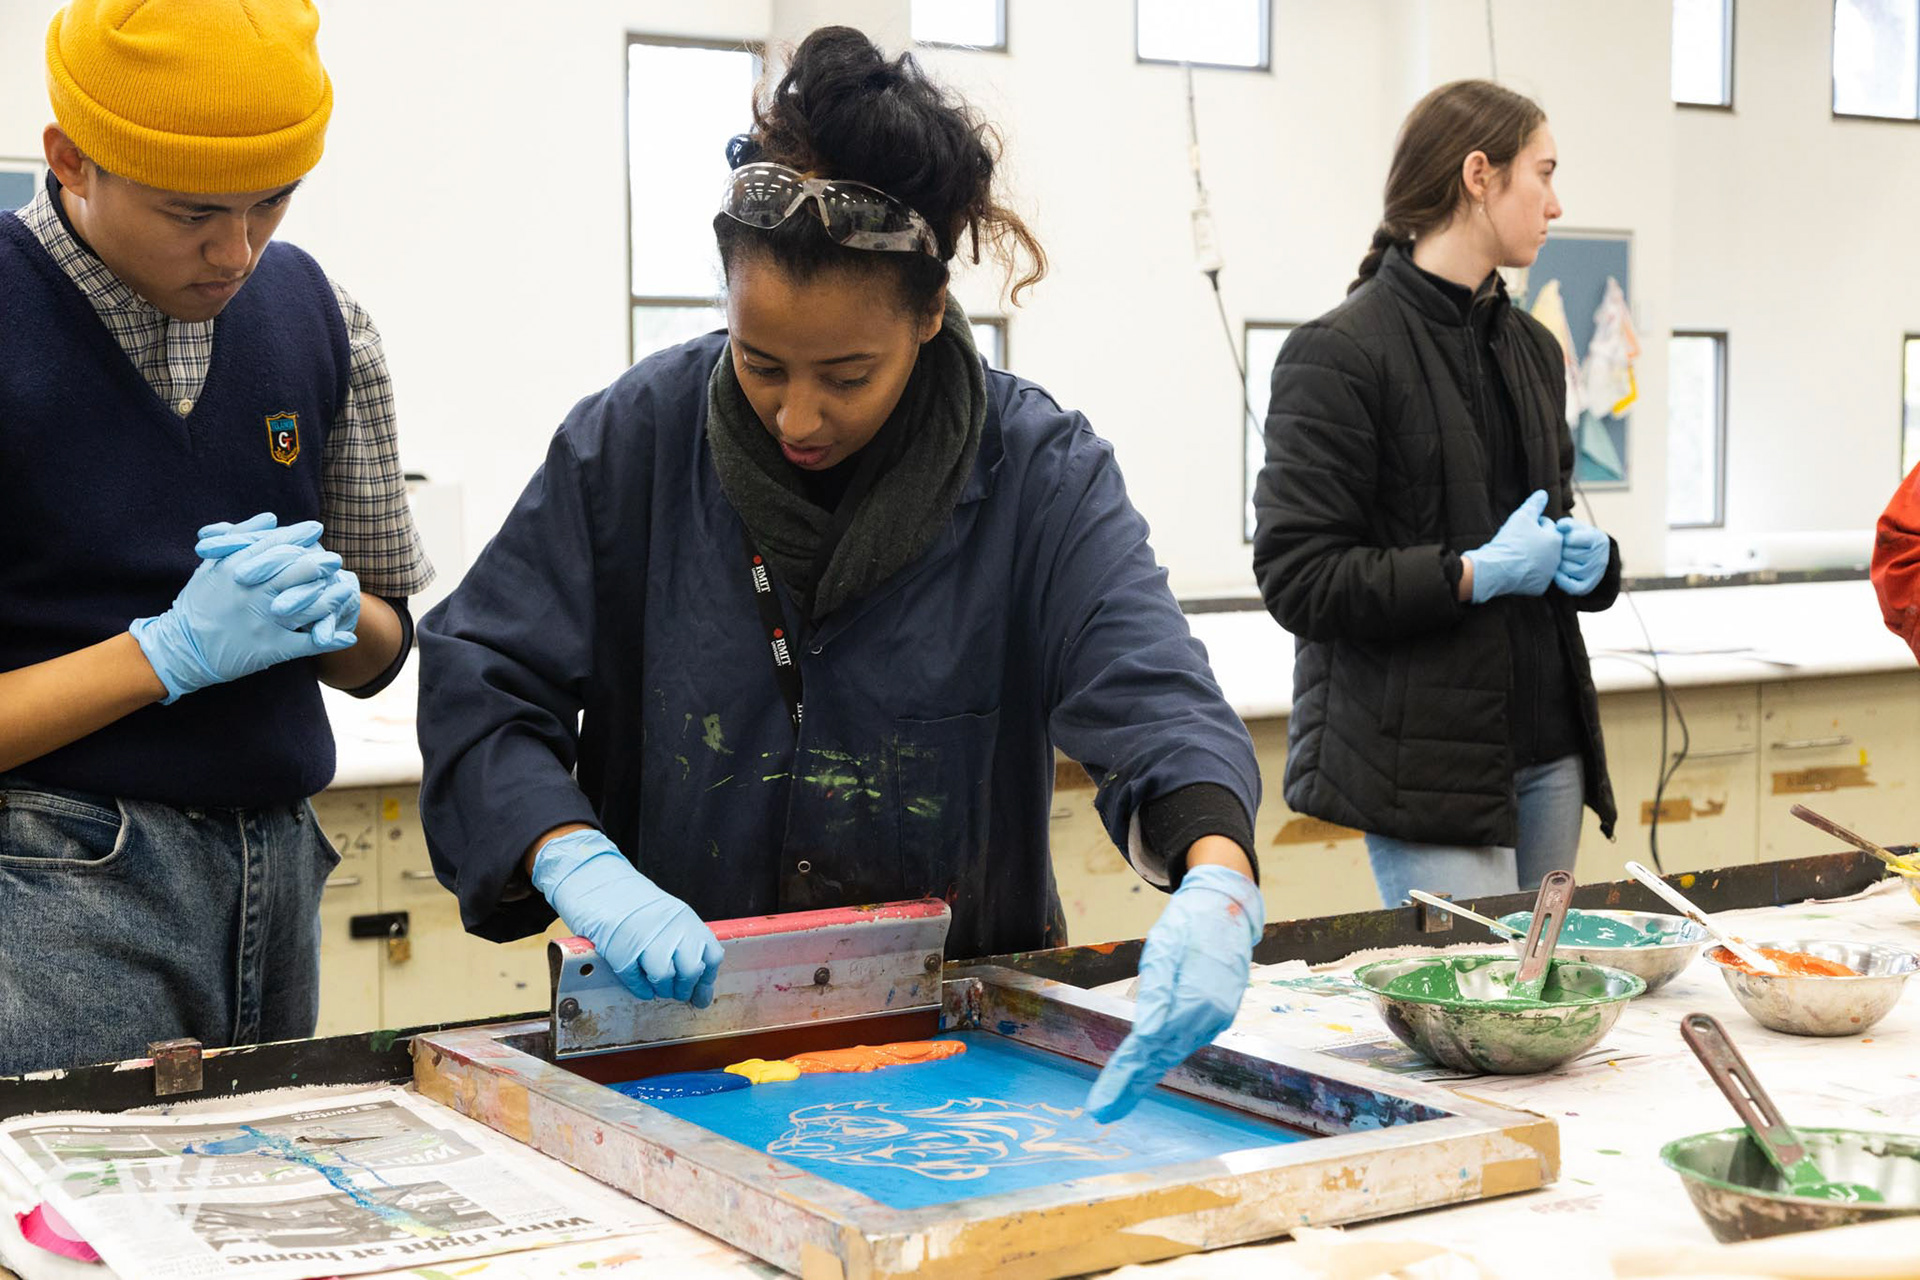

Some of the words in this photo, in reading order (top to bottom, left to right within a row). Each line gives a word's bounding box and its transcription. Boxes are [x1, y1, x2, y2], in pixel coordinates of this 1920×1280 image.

[755, 565, 771, 593] RMIT
[776, 638, 792, 666] RMIT
[293, 1106, 359, 1121] punters
[494, 1216, 595, 1238] Winx
[347, 1247, 387, 1259] at
[394, 1233, 489, 1254] right
[228, 1250, 343, 1265] home
